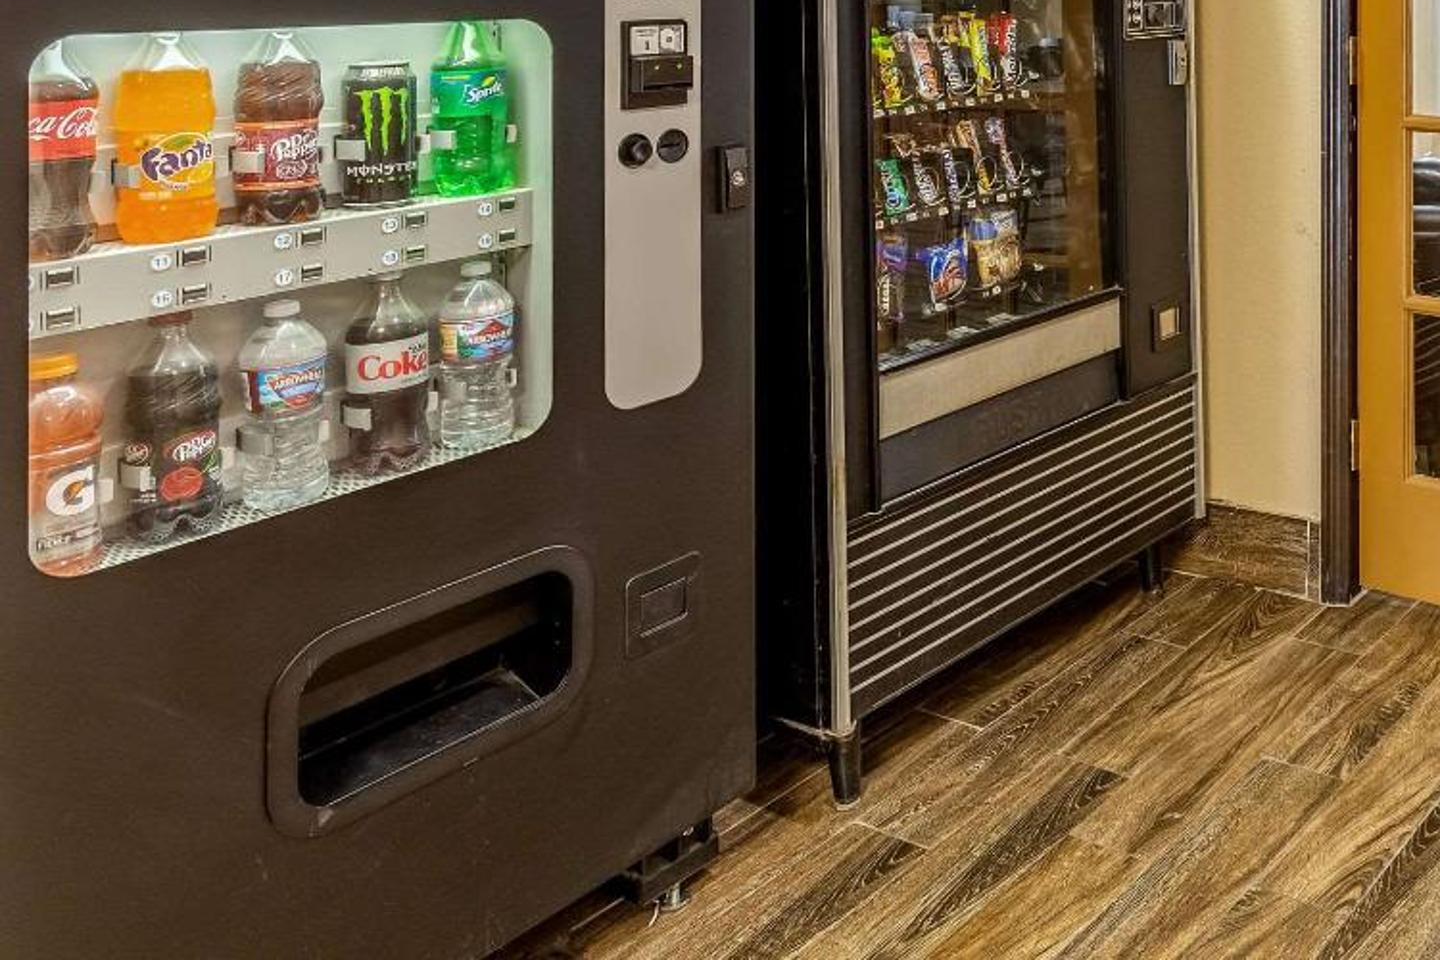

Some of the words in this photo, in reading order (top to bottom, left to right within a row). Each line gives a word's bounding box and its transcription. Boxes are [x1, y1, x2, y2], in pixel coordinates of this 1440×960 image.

[465, 82, 503, 104] Sprite
[140, 140, 213, 181] Fanta
[357, 350, 427, 381] Coke
